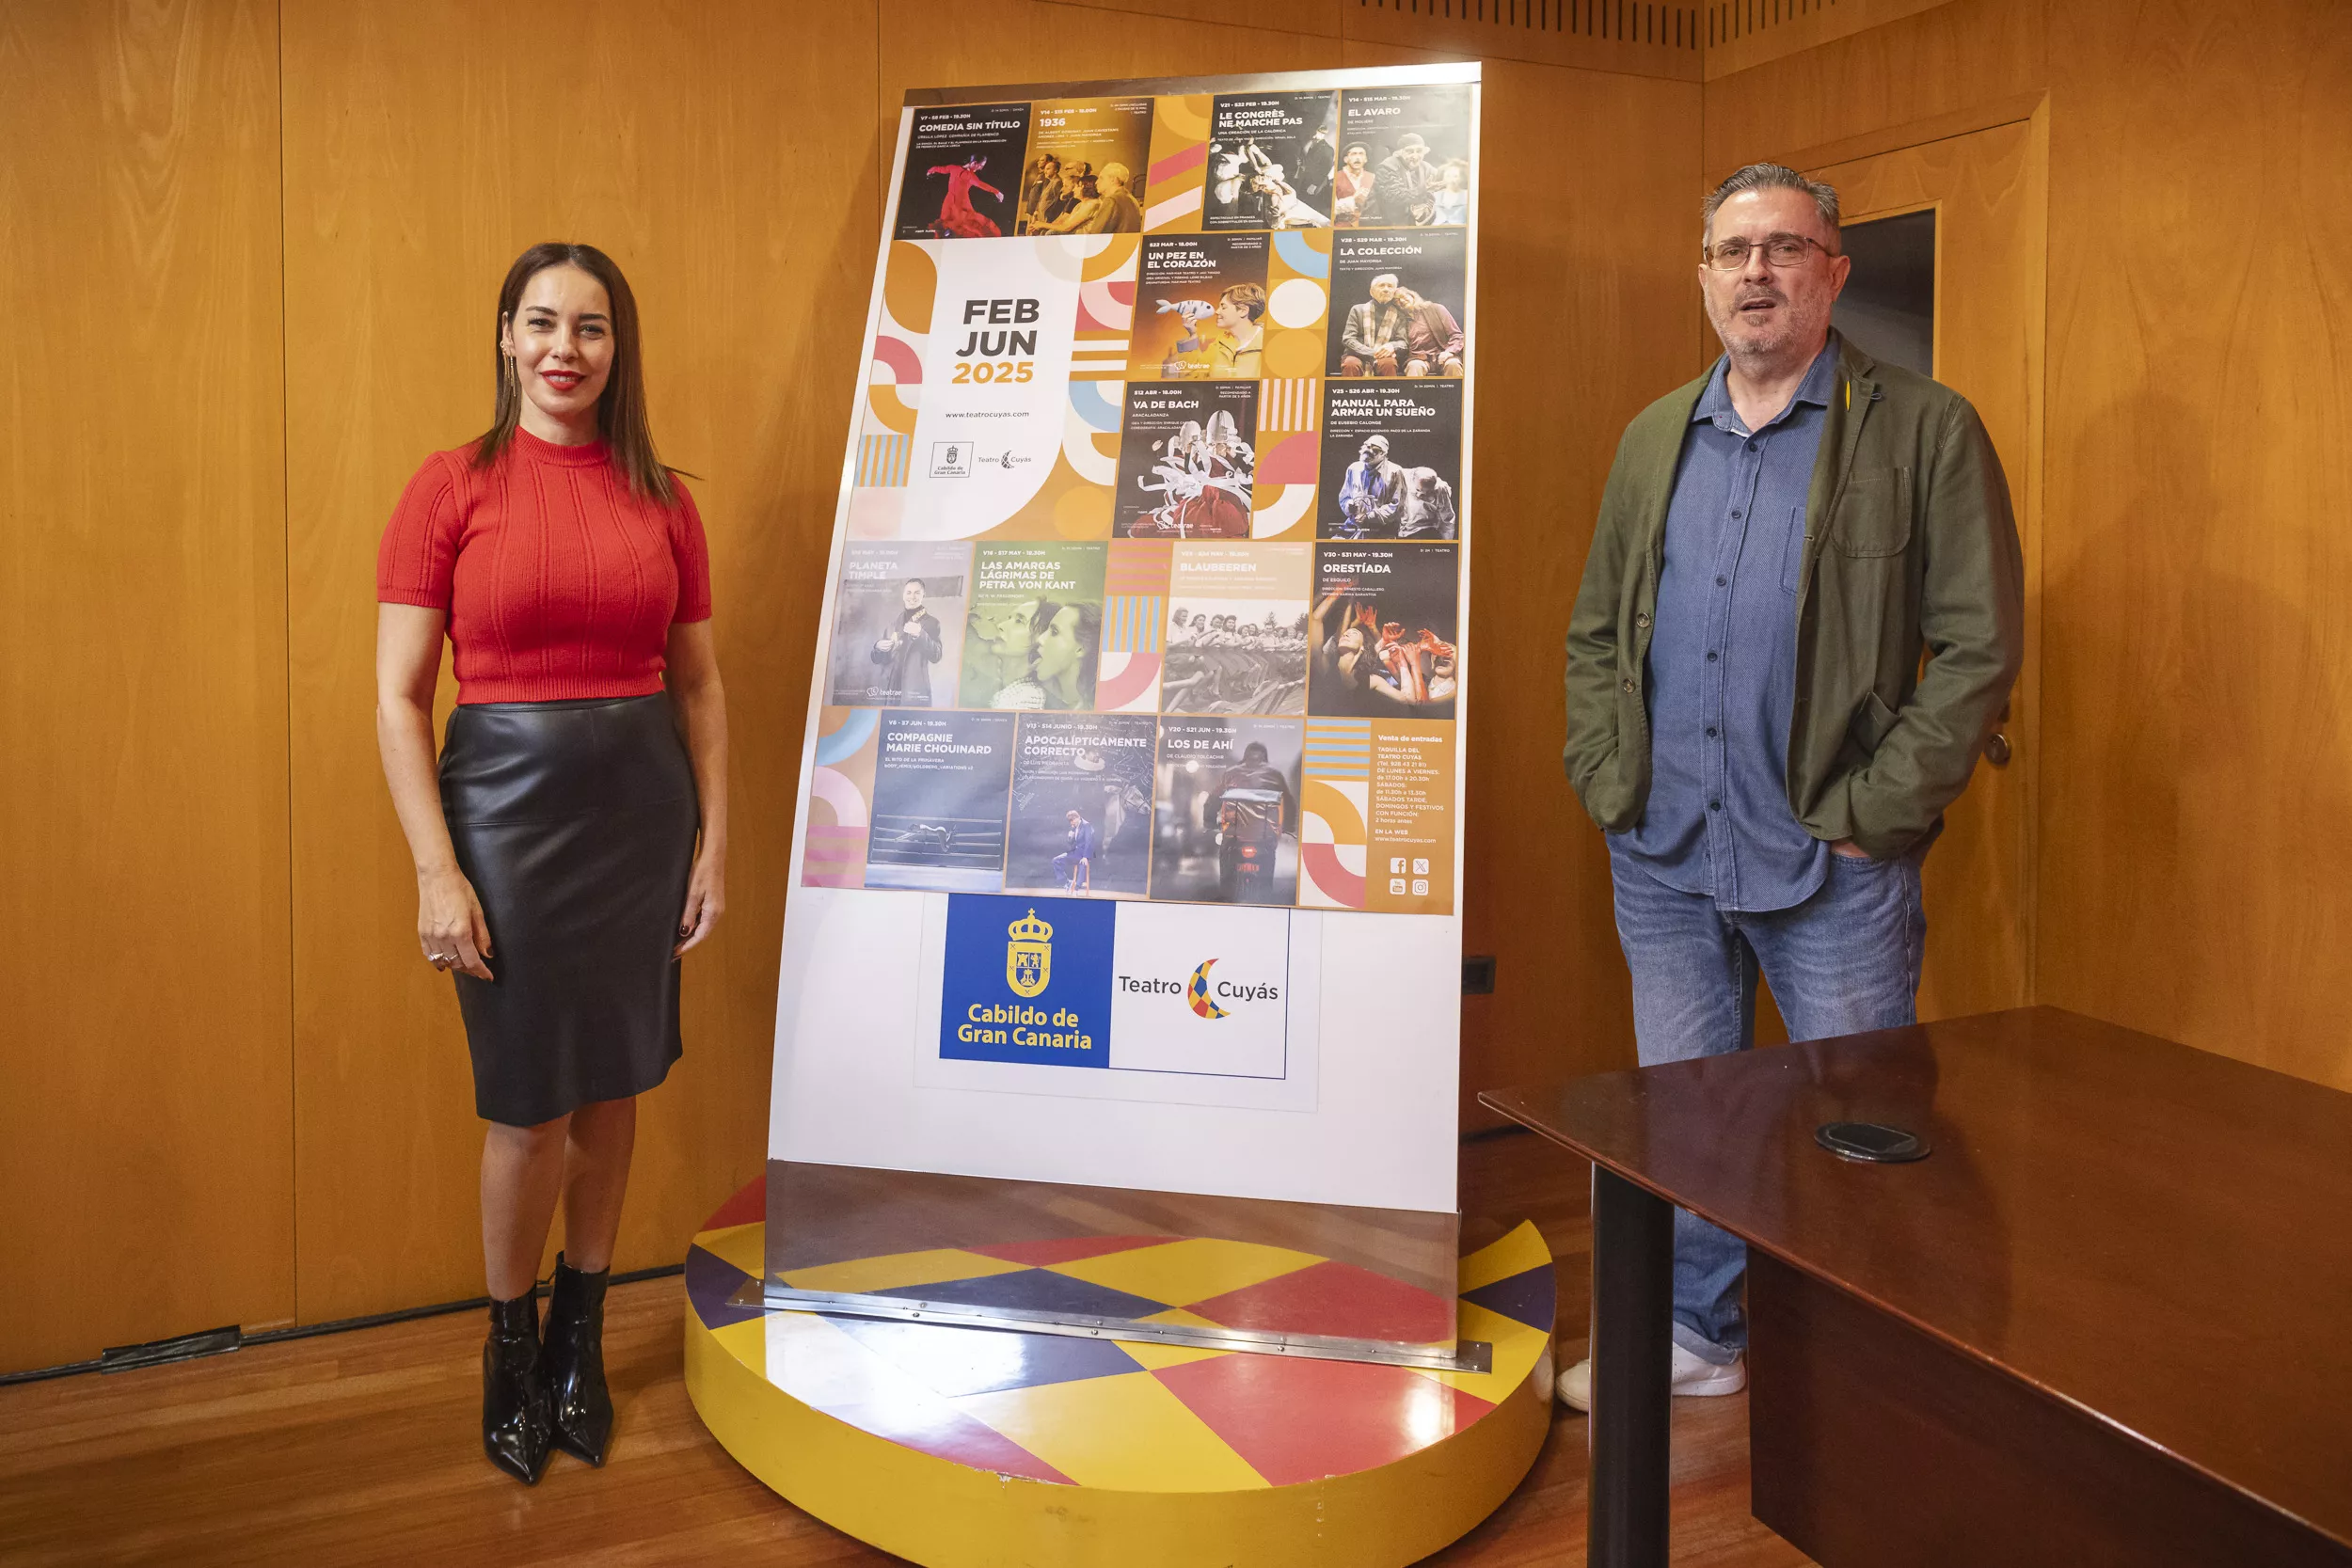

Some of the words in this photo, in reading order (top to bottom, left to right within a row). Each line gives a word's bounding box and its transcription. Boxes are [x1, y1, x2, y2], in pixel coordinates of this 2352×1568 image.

[1234, 109, 1284, 119] CONGRÈS
[985, 120, 1020, 129] TÍTULO
[1040, 119, 1066, 127] 1936
[1236, 119, 1279, 127] MARCHE
[1358, 245, 1422, 255] COLECCIÓN
[1163, 259, 1216, 267] CORAZÓN
[963, 299, 1040, 325] FEB
[956, 330, 1037, 356] JUN
[952, 362, 1033, 384] 2025
[1395, 406, 1436, 416] SUEÑO
[850, 562, 898, 570] PLANETA
[1006, 562, 1061, 570] AMARGAS
[1181, 562, 1257, 572] BLAUBEEREN
[1323, 562, 1391, 573] ORESTÍADA
[980, 569, 1037, 579] LÁGRIMAS
[887, 733, 953, 742] COMPAGNIE
[1025, 736, 1147, 747] APOCALÍPTICAMENTE
[924, 744, 992, 754] CHOUINARD
[1168, 739, 1190, 749] LOS
[1193, 740, 1209, 749] DE
[1213, 739, 1234, 750] AHÍ
[1025, 747, 1085, 756] CORRECTO
[1119, 975, 1182, 995] Teatro
[1217, 981, 1278, 1002] Cuyás
[968, 1004, 1048, 1027] Cabildo
[1052, 1008, 1078, 1028] de
[958, 1024, 1007, 1044] Gran
[1012, 1028, 1092, 1050] Canaria
